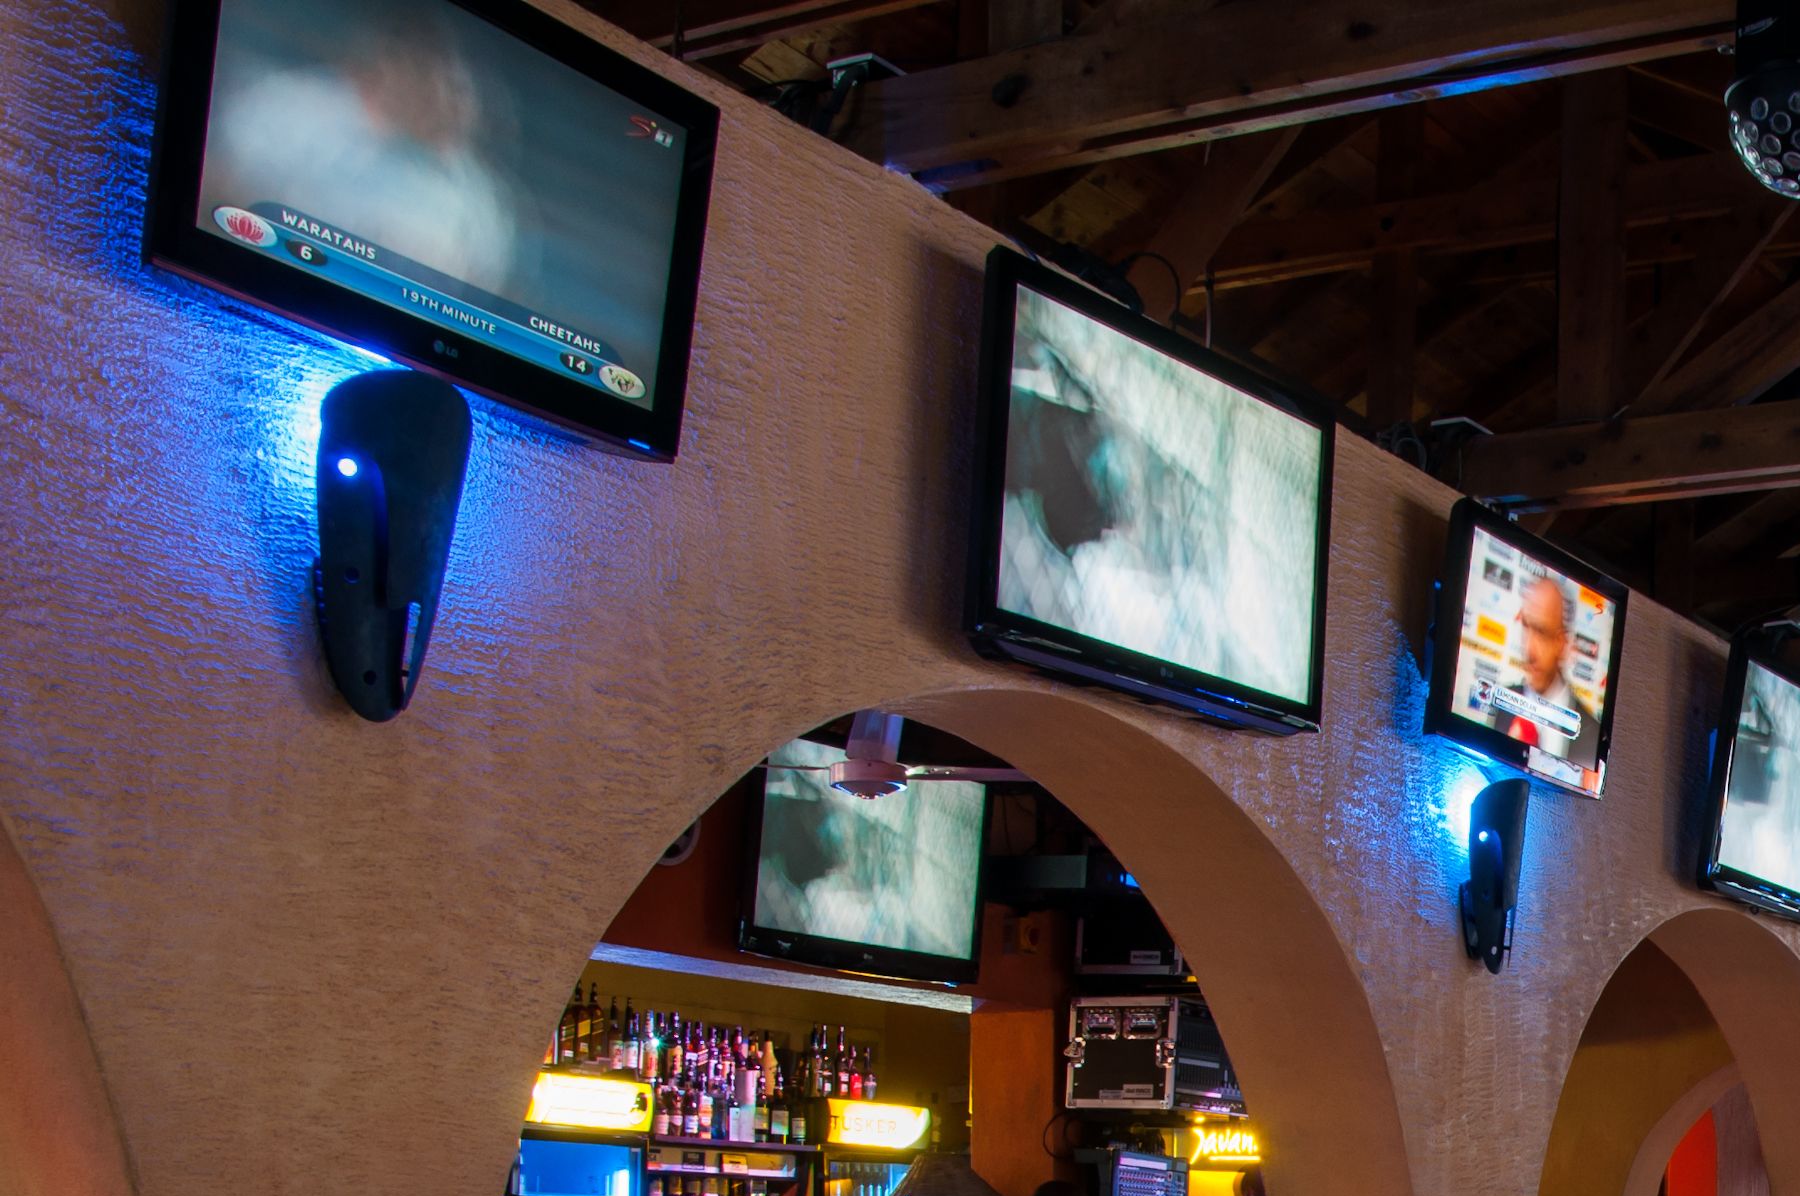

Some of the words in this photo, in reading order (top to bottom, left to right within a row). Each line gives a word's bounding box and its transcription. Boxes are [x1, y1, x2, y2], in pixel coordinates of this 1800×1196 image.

[281, 209, 377, 260] WARATAHS
[300, 245, 312, 260] 6
[402, 287, 439, 311] 19TH
[441, 301, 496, 334] MINUTE
[529, 316, 601, 354] CHEETAHS
[567, 355, 587, 373] 14
[831, 1114, 897, 1135] TUSKER
